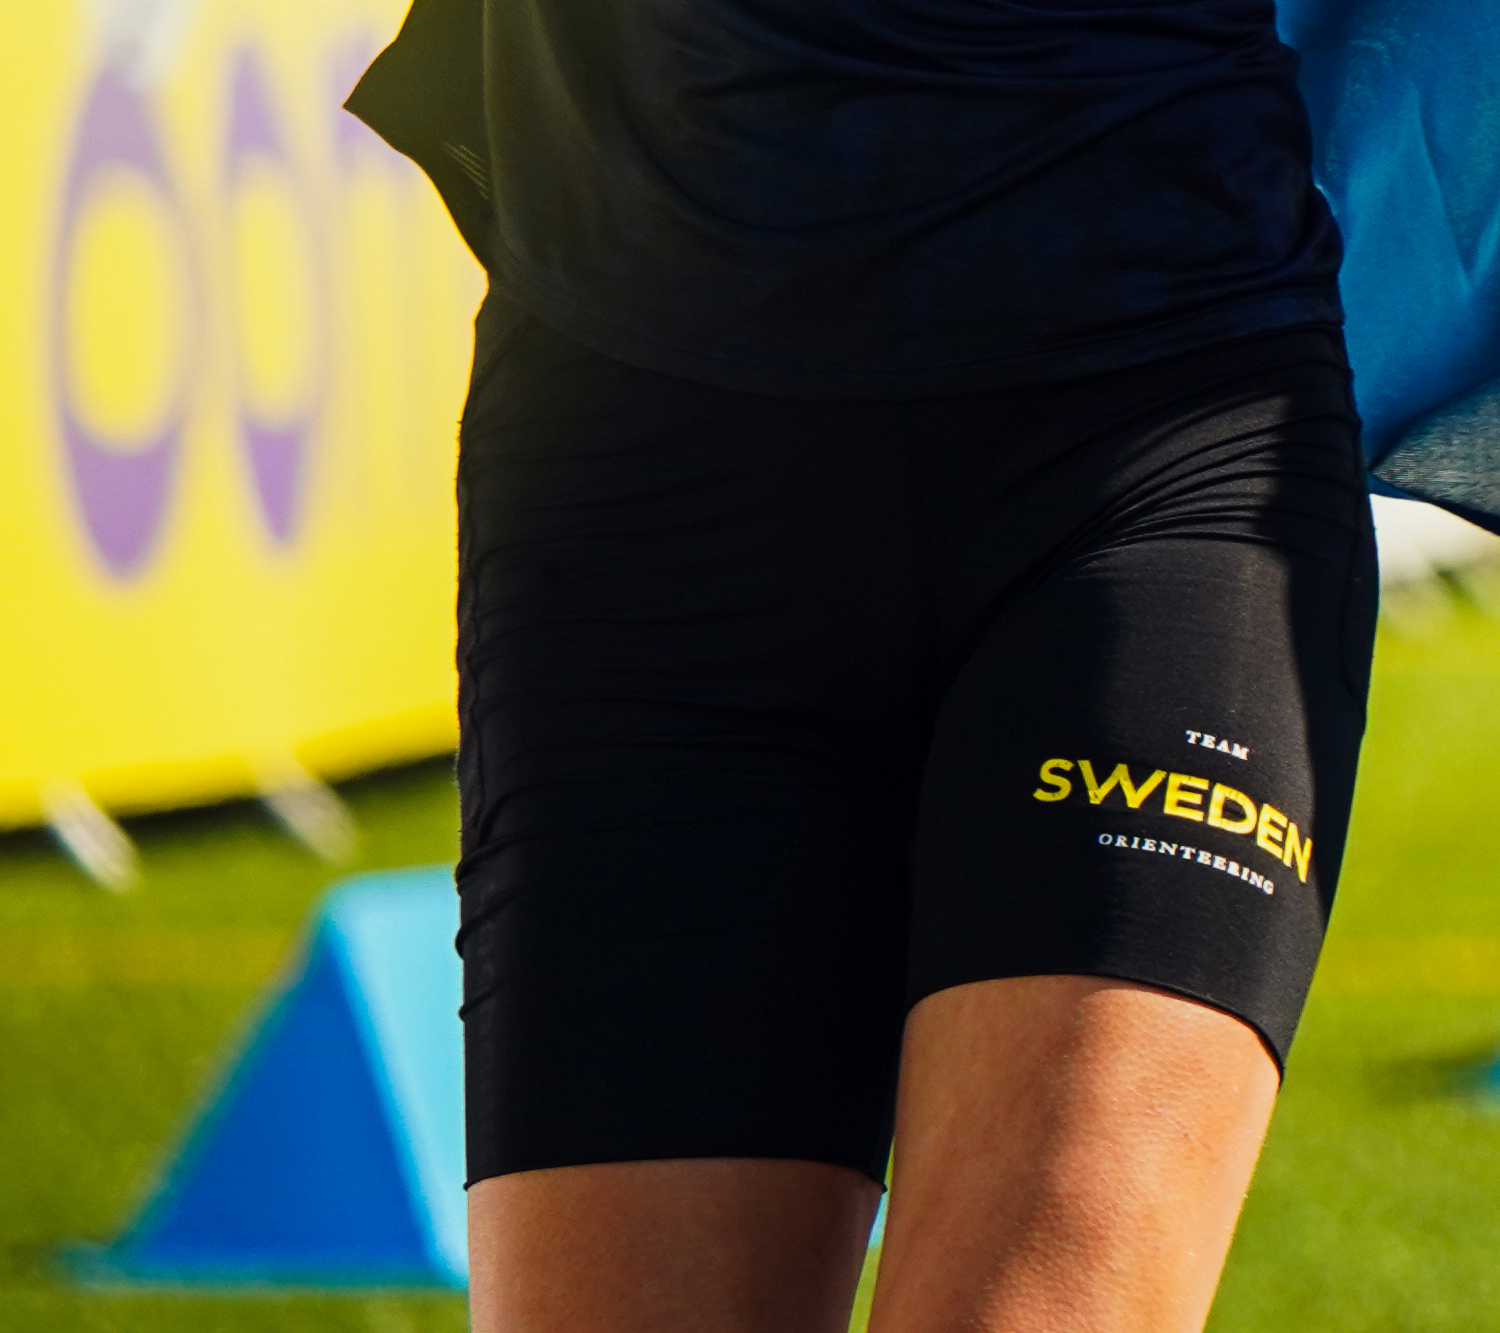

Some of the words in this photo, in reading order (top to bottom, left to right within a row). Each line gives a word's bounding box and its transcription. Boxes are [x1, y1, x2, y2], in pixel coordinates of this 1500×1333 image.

[1185, 729, 1250, 761] TEAM
[1032, 757, 1313, 884] SWEDEN
[1098, 832, 1275, 896] ORIENTEERING
